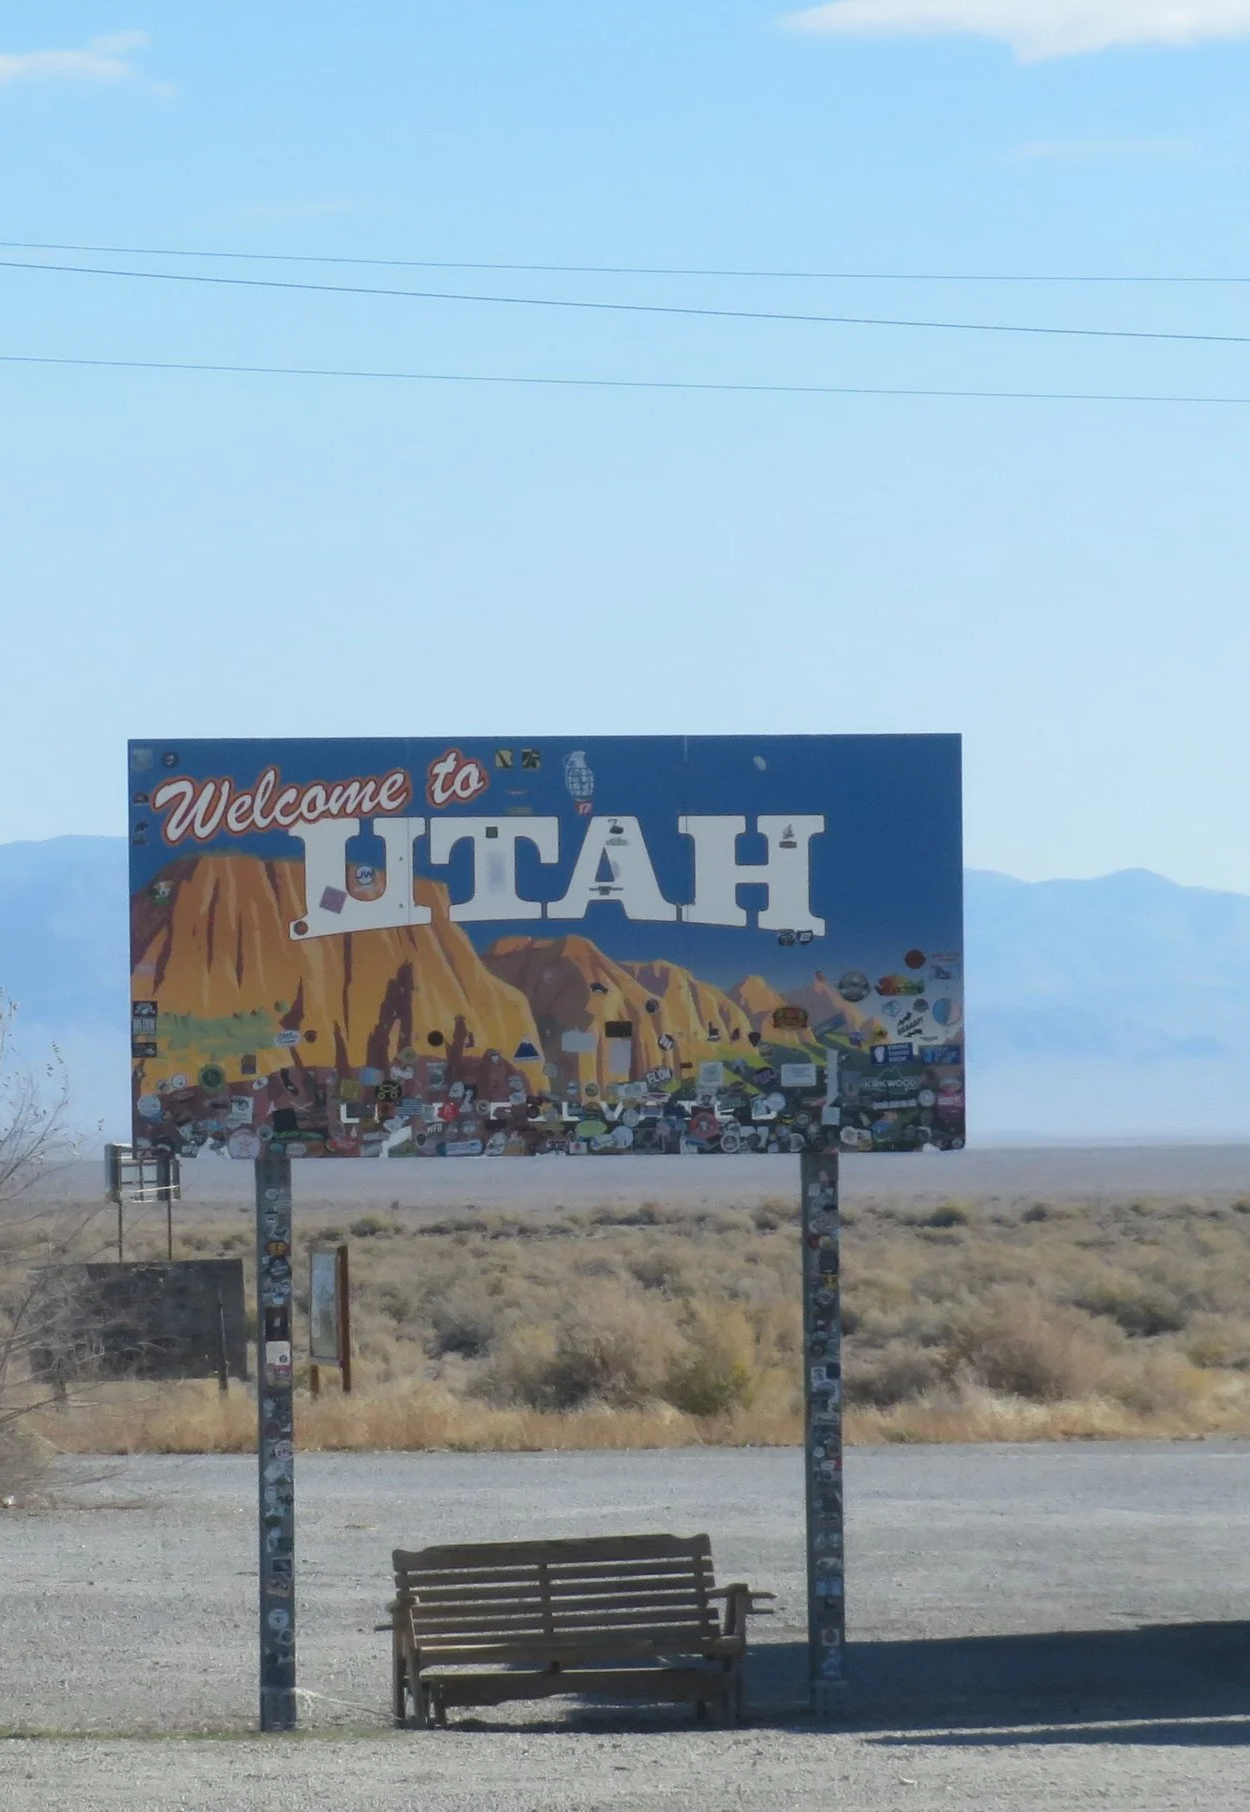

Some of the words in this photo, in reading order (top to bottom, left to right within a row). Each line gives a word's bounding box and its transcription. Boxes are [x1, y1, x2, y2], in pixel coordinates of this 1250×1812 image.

[154, 765, 407, 843] Welcome
[431, 749, 484, 804] to
[289, 813, 825, 941] UTAH
